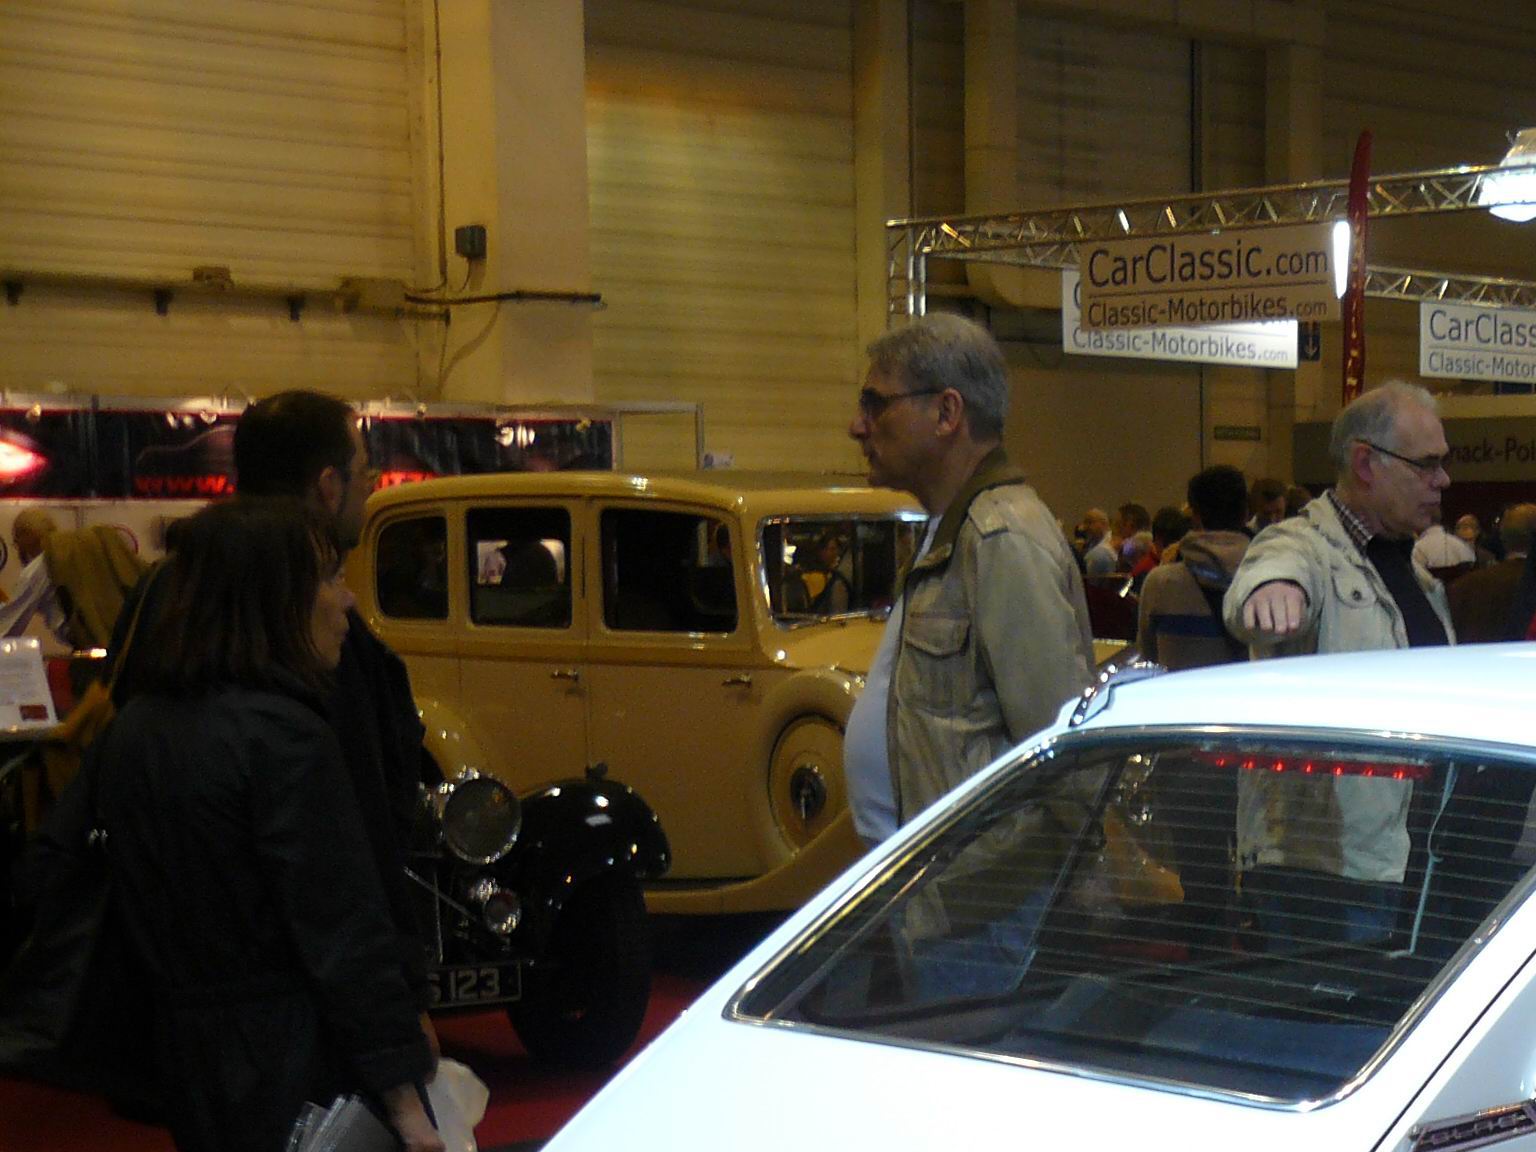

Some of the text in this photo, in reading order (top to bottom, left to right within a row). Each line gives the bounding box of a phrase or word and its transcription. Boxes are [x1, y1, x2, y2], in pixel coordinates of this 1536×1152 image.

[1088, 239, 1329, 288] CarClassic.com
[1088, 293, 1328, 328] Classic-Motorbikes.com
[449, 967, 500, 1000] 123
